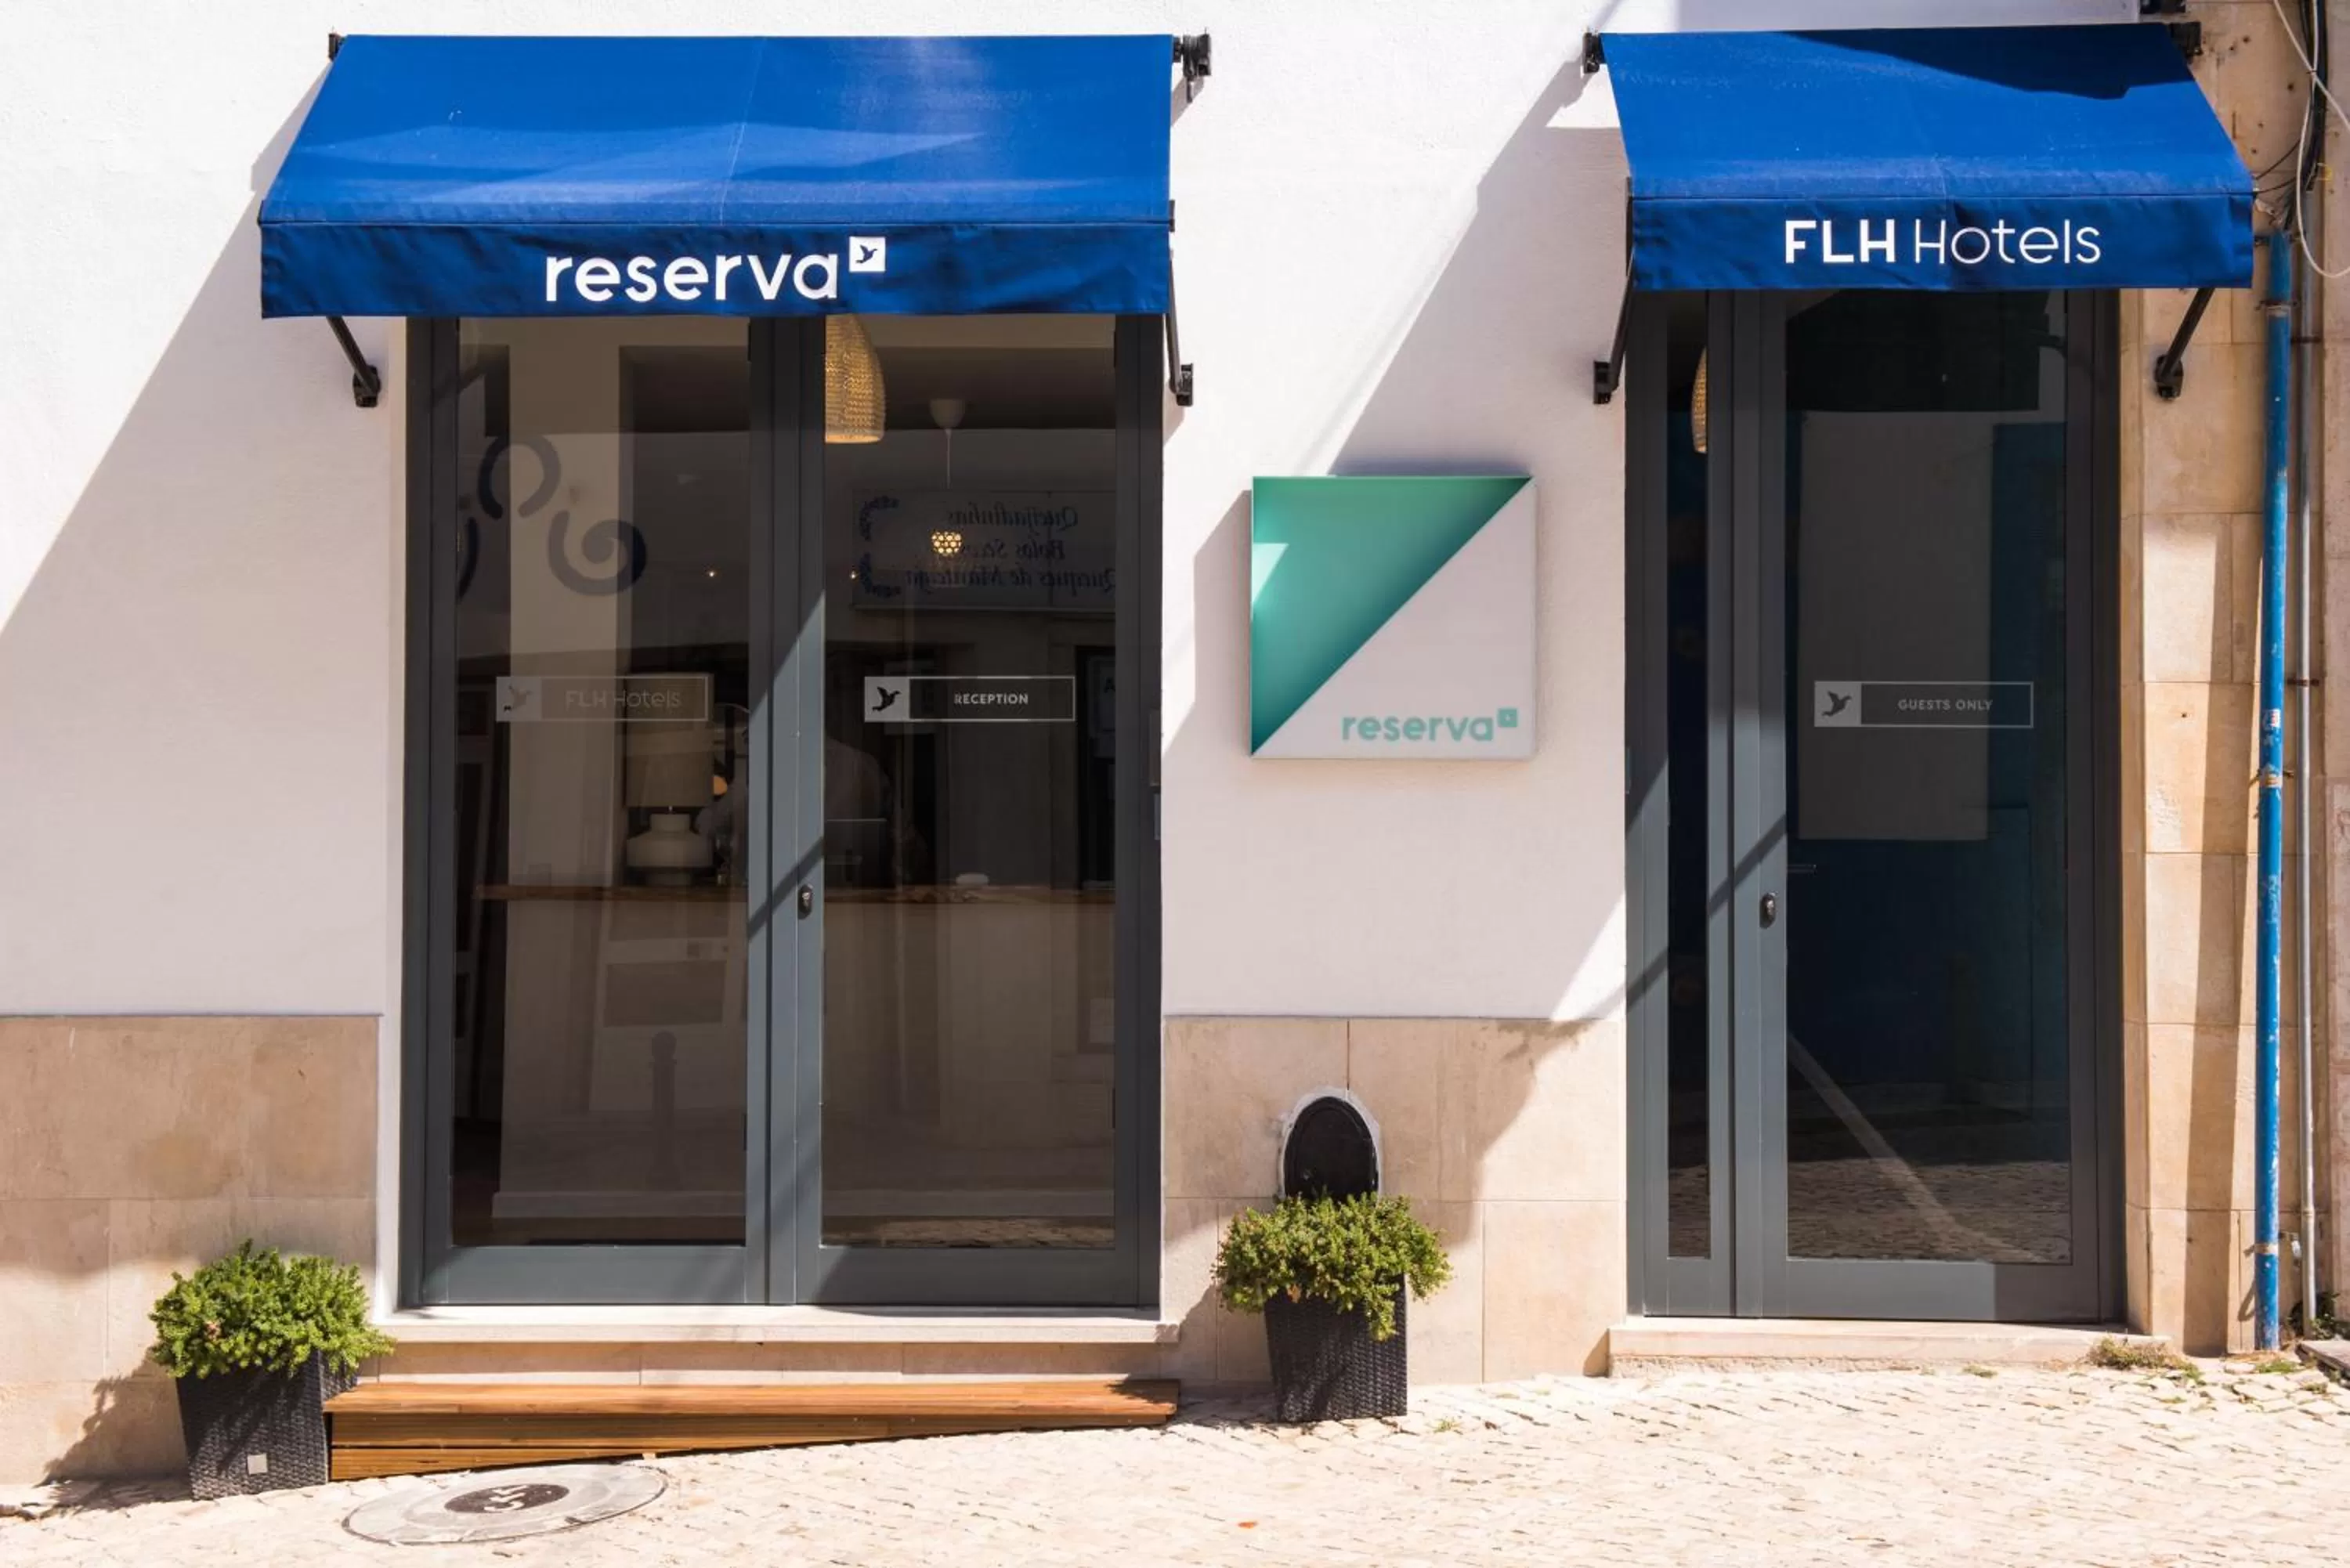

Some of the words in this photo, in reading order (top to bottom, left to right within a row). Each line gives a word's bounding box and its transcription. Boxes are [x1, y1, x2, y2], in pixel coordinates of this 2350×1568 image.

[1784, 219, 1896, 264] FLH
[1914, 219, 2102, 265] Hotels
[545, 253, 838, 302] reserva
[564, 688, 608, 709] FLH
[613, 688, 682, 709] Hotels
[953, 692, 1029, 705] RECEPTION
[1896, 698, 1951, 711] GUESTS
[1954, 698, 1994, 711] ONLY
[1341, 716, 1495, 742] reserva
